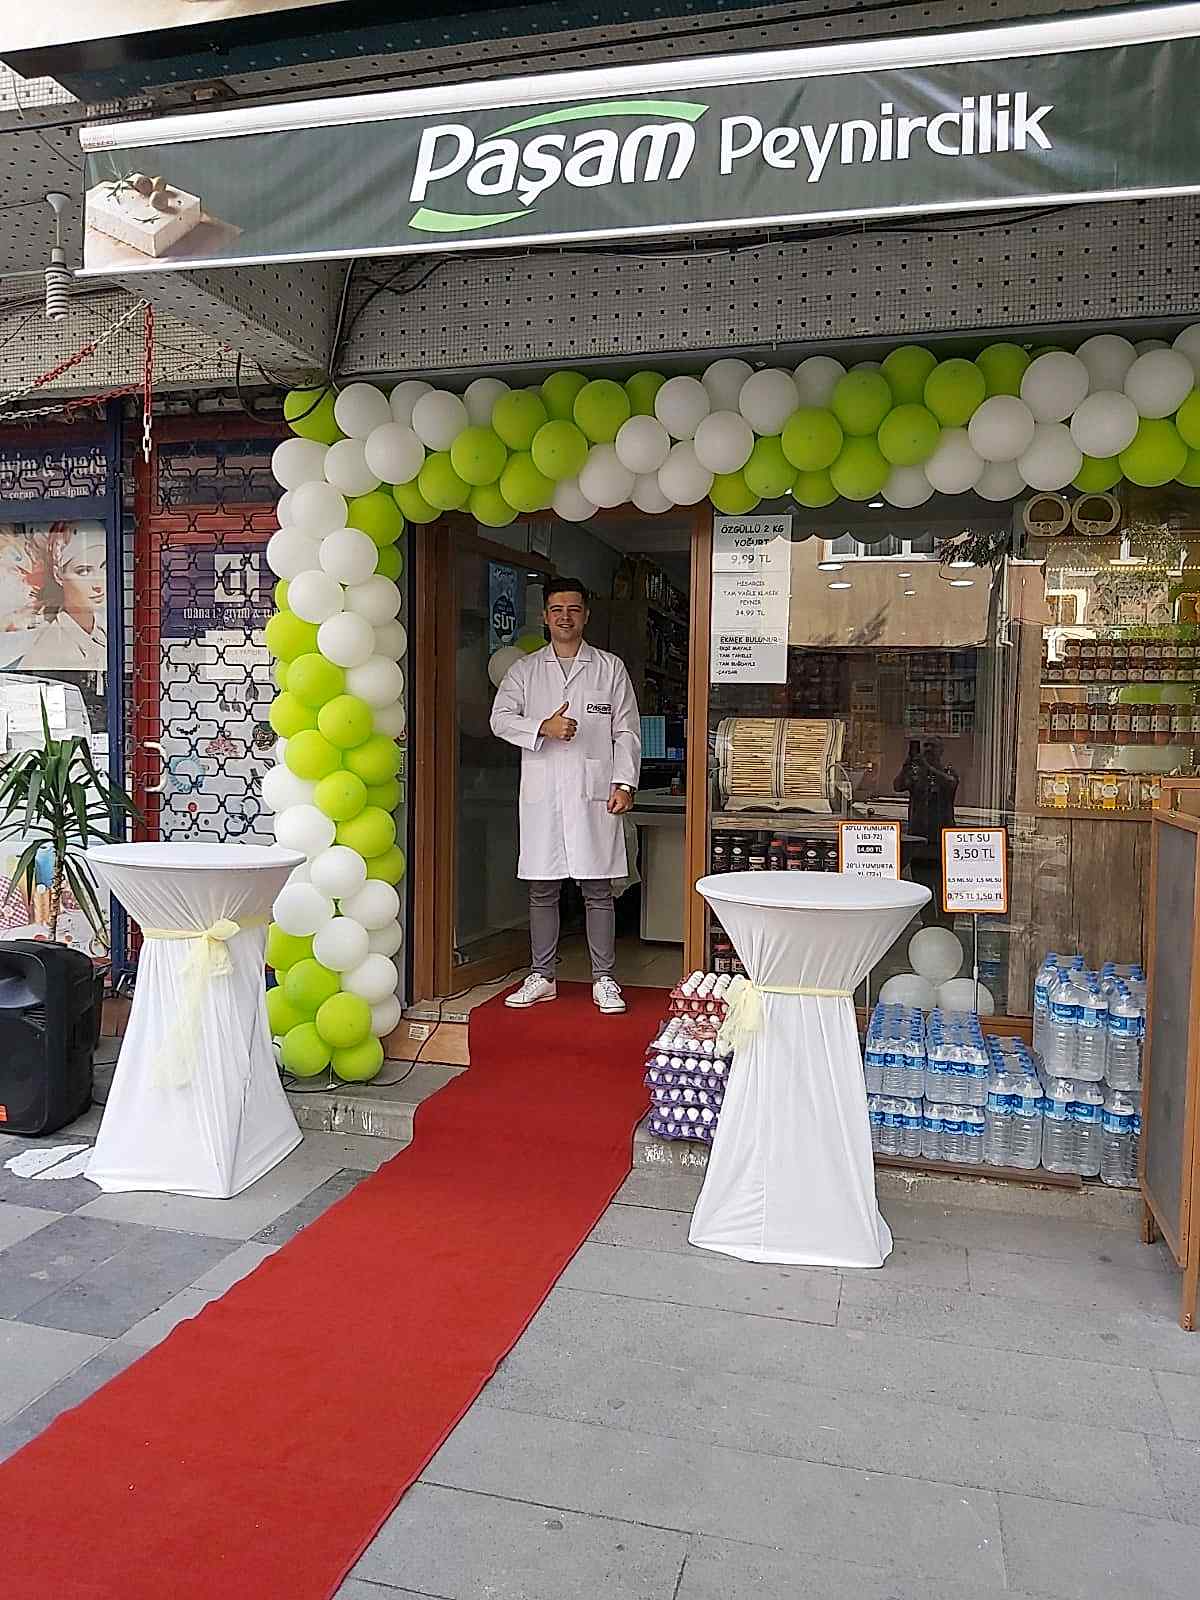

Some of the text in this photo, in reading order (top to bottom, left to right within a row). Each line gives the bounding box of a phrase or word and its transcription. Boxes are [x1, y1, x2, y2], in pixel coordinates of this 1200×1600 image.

[408, 91, 1055, 207] Paşam Peynircilik
[721, 524, 784, 534] ÖZGÜLLÜ 2 KG
[734, 537, 770, 548] YOĞURT
[759, 554, 772, 564] TL
[493, 611, 516, 631] SÜT
[976, 833, 990, 843] SU
[953, 848, 996, 861] 3,50 TL
